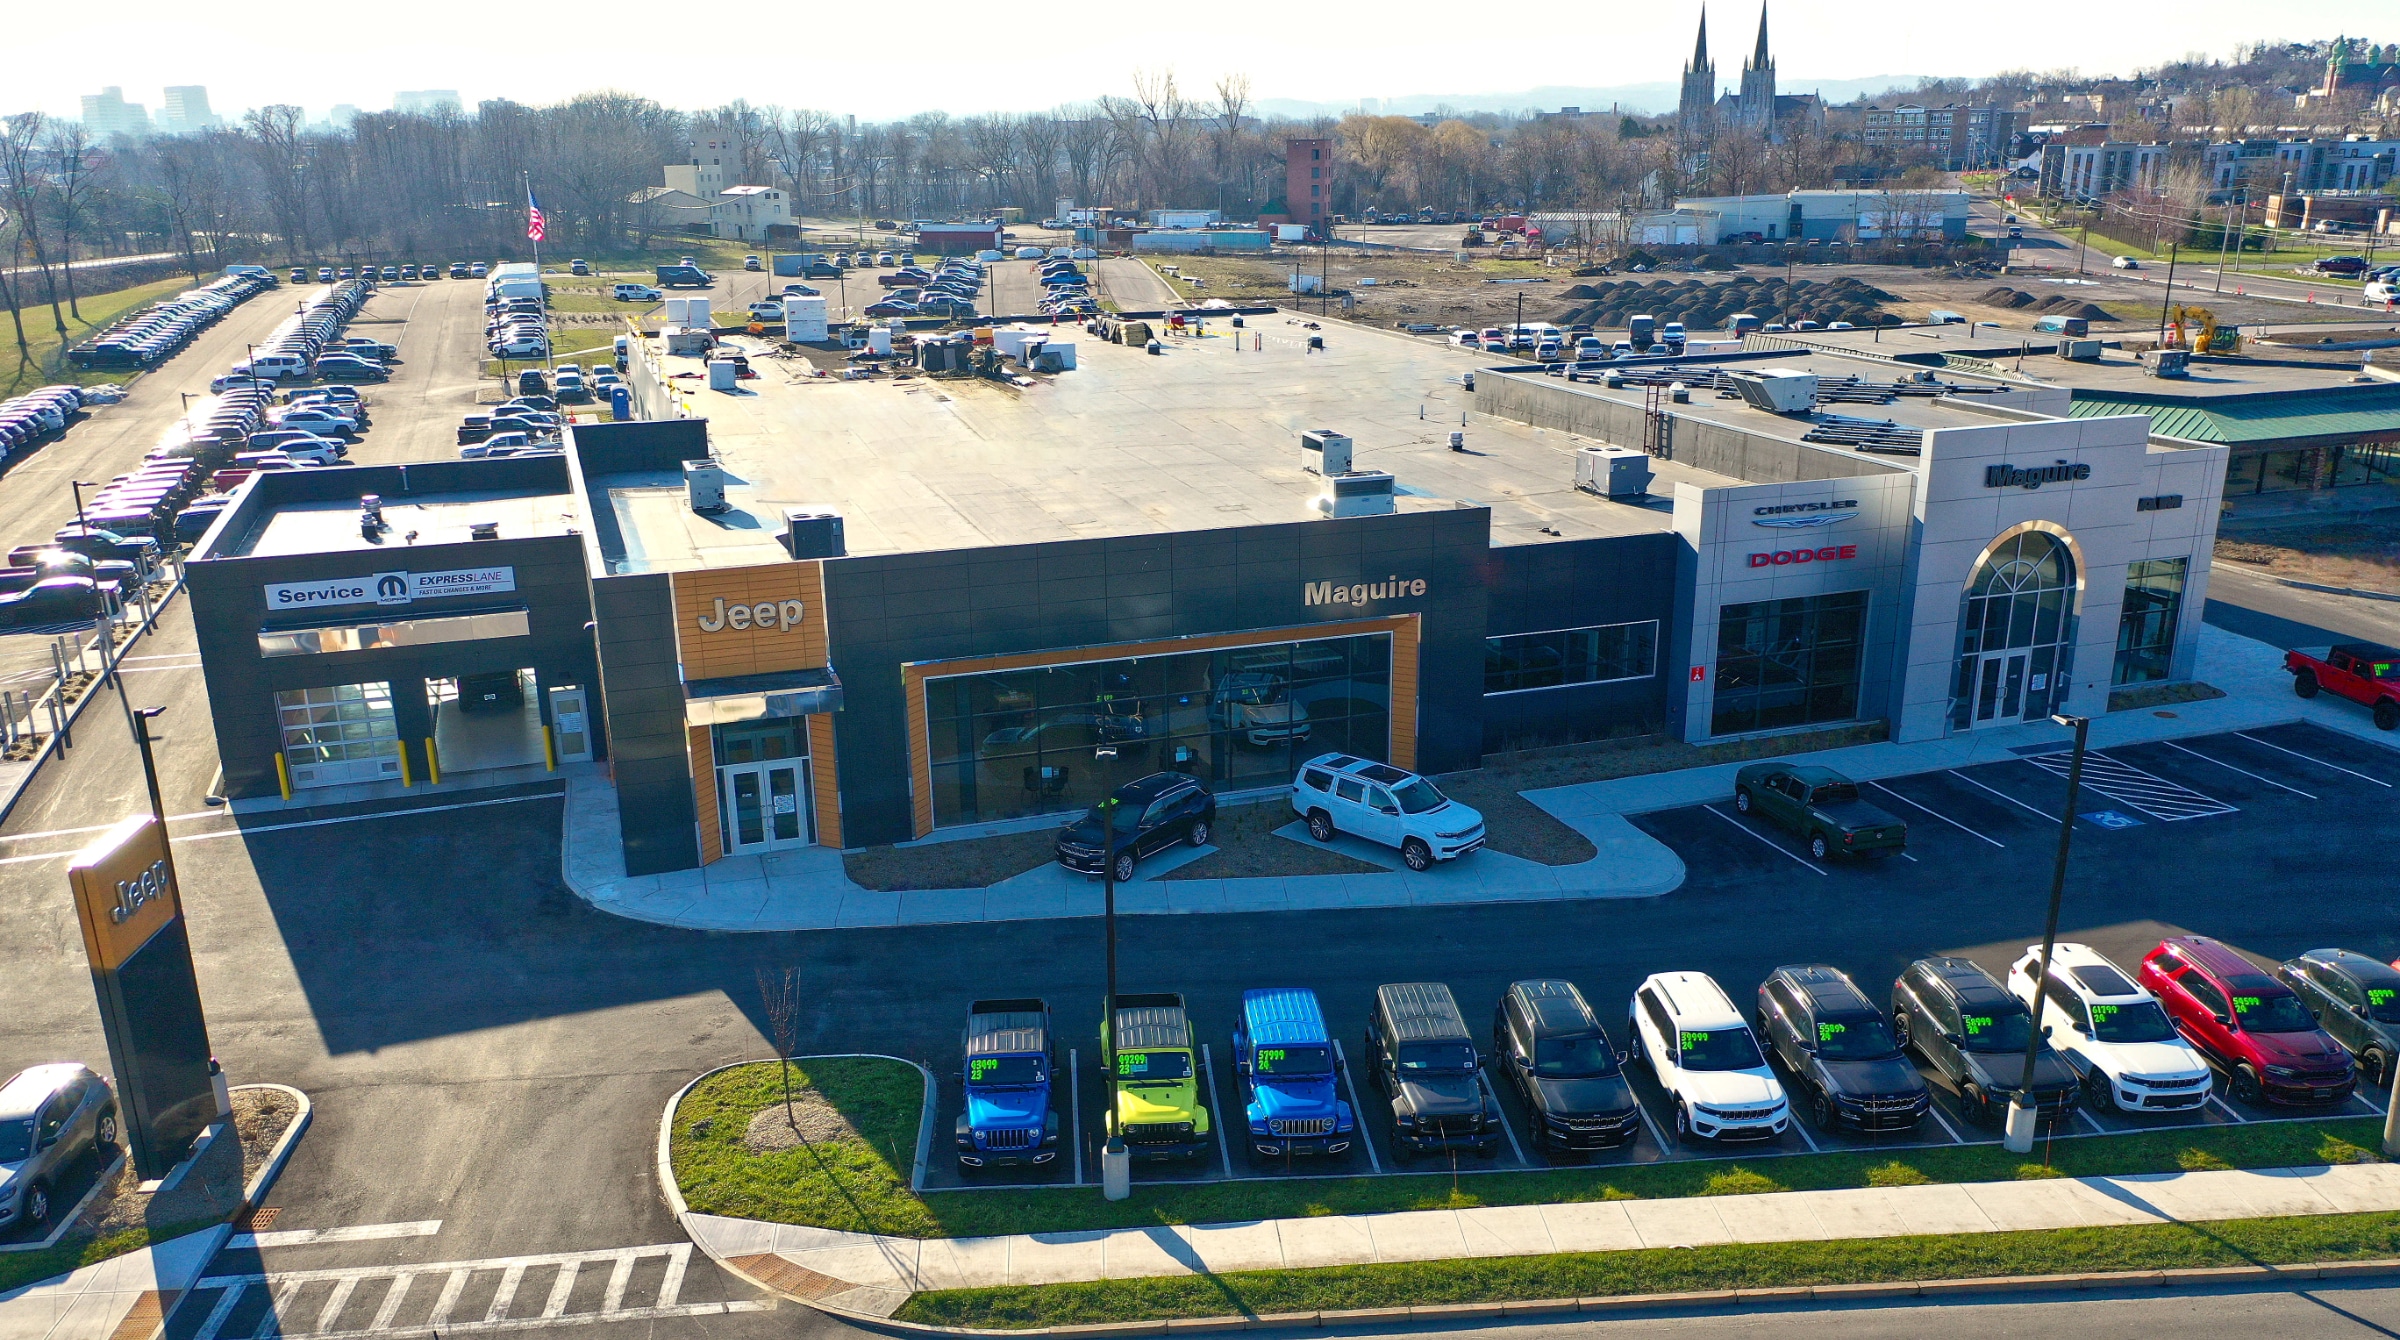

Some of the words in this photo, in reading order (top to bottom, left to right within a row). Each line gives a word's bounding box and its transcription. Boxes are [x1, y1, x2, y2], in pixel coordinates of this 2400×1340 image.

[1986, 459, 2091, 489] Maguire
[1754, 500, 1858, 515] CHRYSLER
[1750, 545, 1857, 568] DODGE
[278, 585, 364, 604] Service
[1304, 575, 1427, 607] Maguire
[697, 596, 804, 633] Jeep
[109, 860, 168, 925] Jeep
[1681, 1032, 1708, 1041] 39999
[1258, 1050, 1284, 1060] 57999
[971, 1070, 982, 1080] 23
[1119, 1064, 1130, 1075] 23
